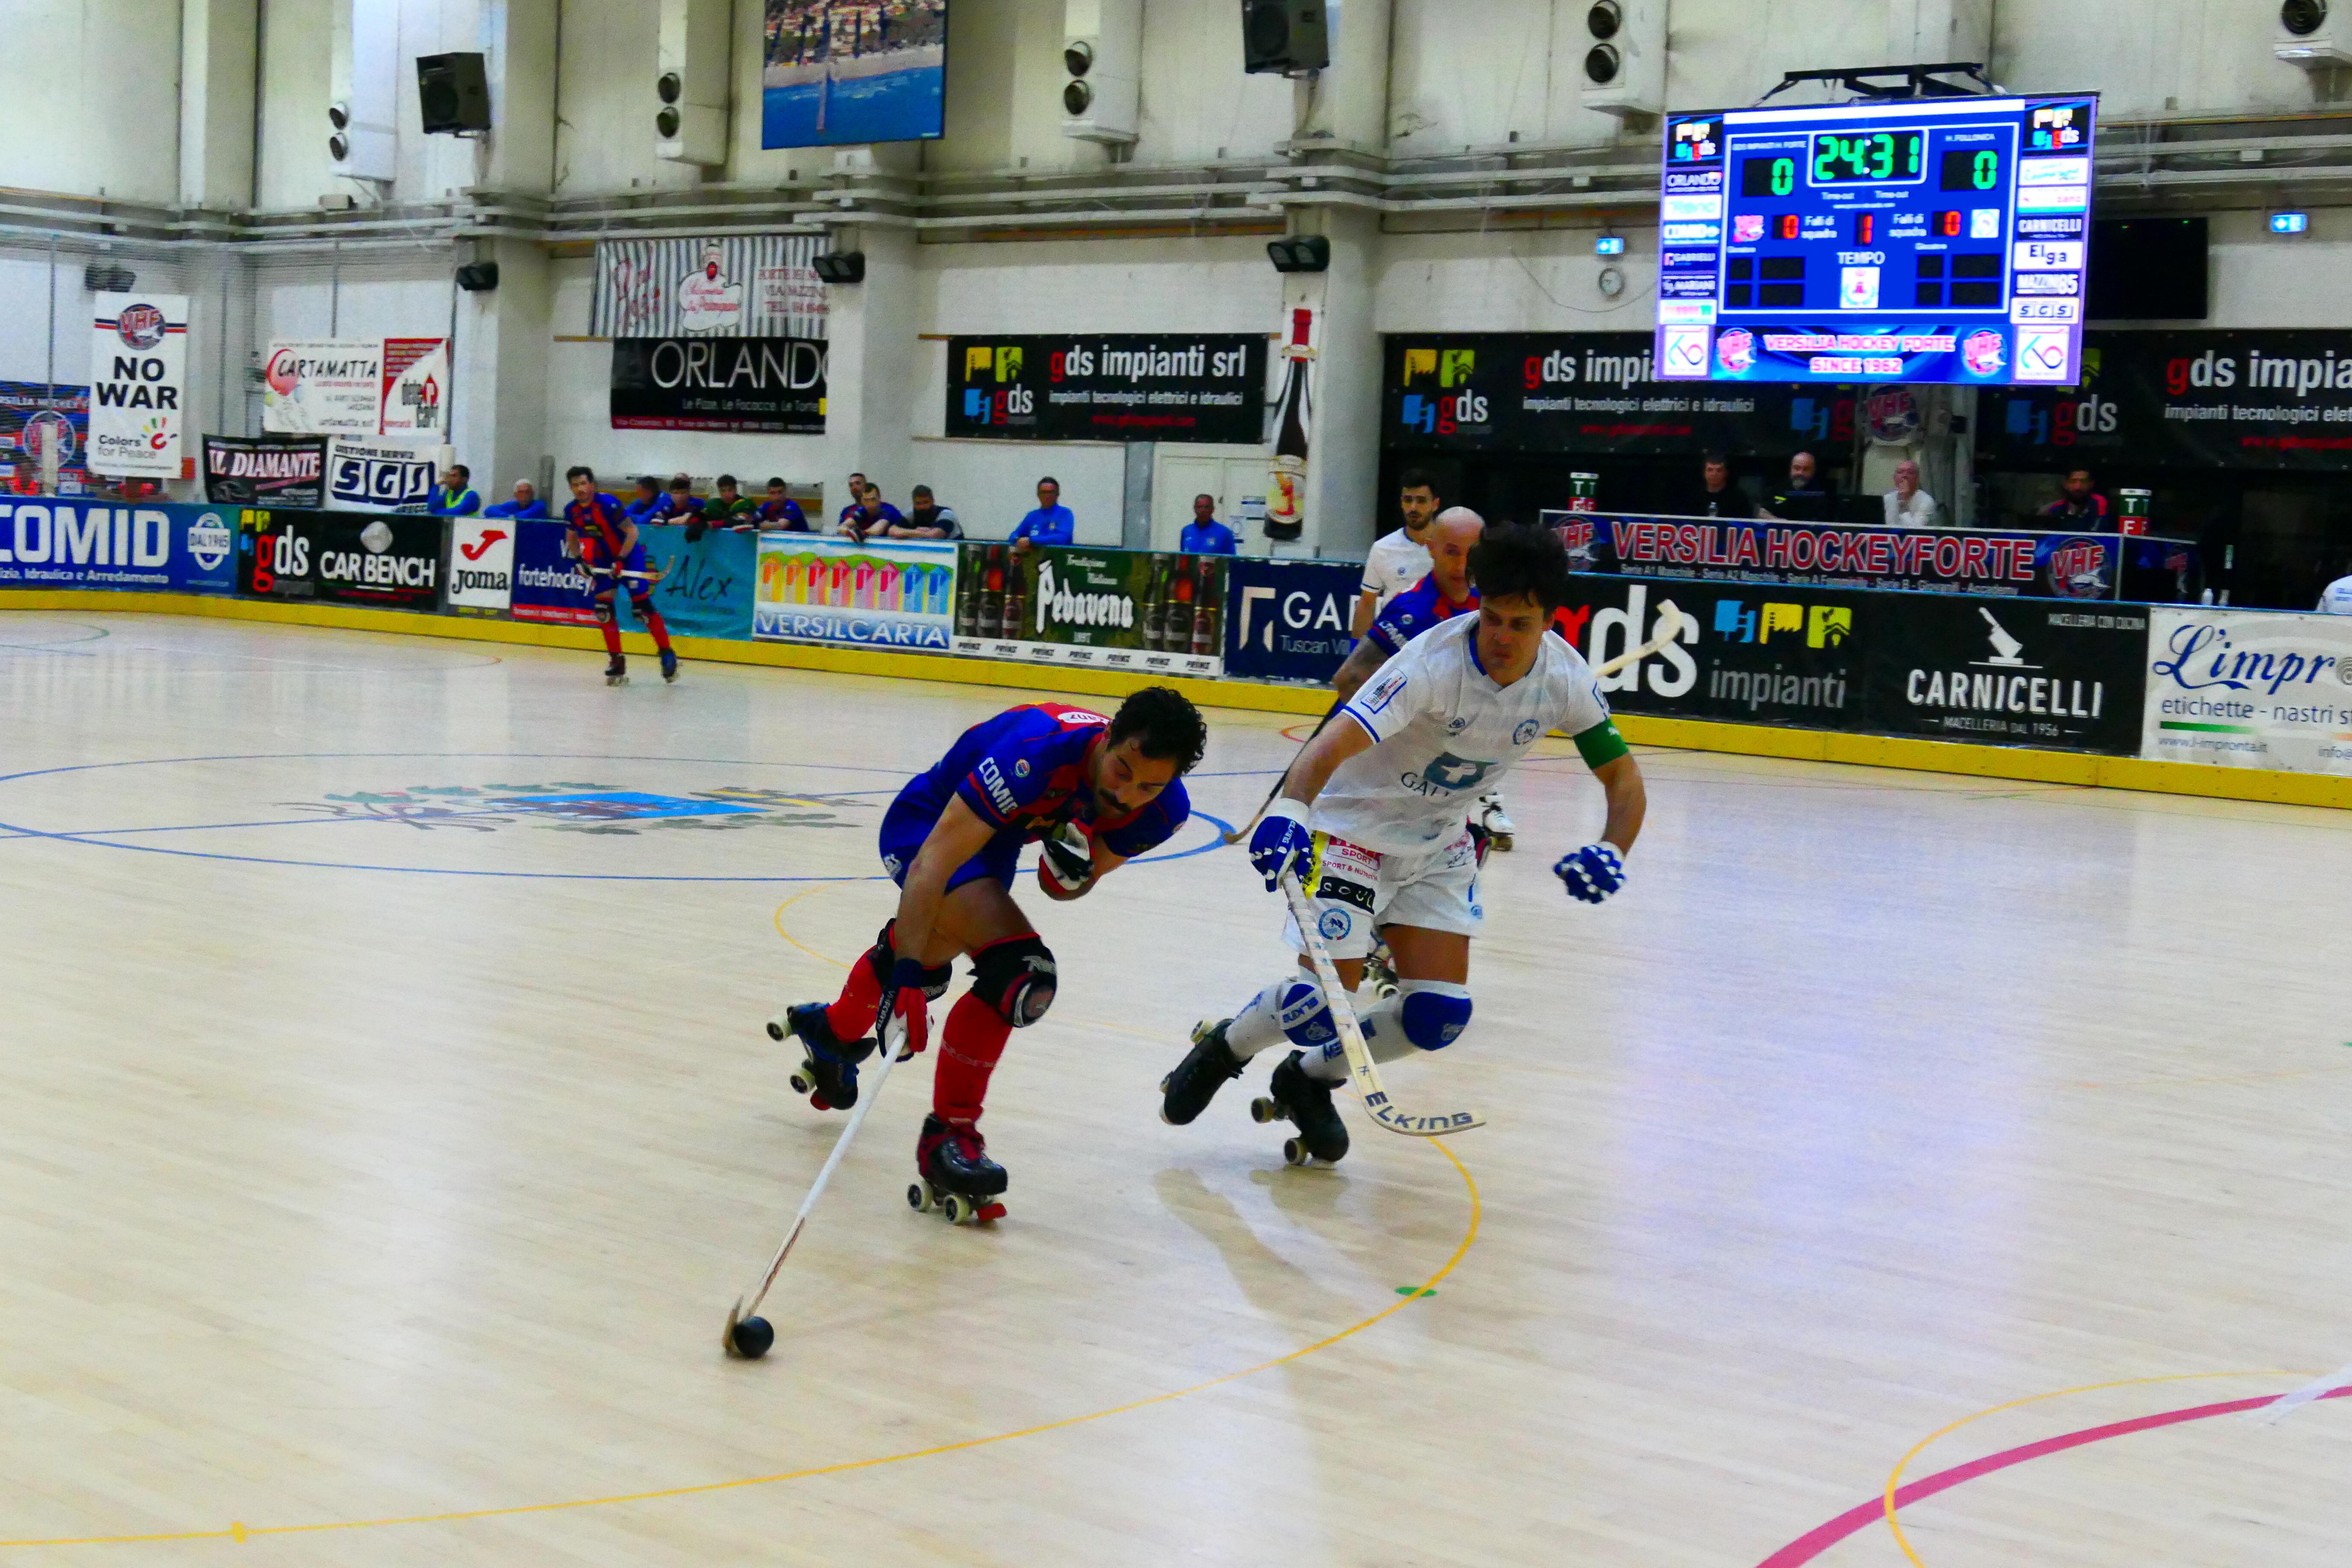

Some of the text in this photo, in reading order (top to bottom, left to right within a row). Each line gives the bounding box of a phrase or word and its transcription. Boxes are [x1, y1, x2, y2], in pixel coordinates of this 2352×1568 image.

[1772, 158, 1794, 195] 0
[1973, 151, 1998, 190] 0
[1783, 215, 1799, 239] 0
[1945, 211, 1961, 236] 0
[1837, 251, 1886, 265] TEMPO
[2030, 245, 2067, 265] Elga
[1763, 334, 1956, 352] VERSILIA HOCKEY FORTE
[114, 356, 164, 381] NO
[278, 359, 377, 378] CARTAMATTA
[1050, 344, 1245, 383] gds impianti srl
[1524, 350, 1576, 389] gds
[1810, 357, 1862, 374] SINCE
[2167, 349, 2236, 395] gds
[96, 383, 177, 409] WAR
[993, 384, 1033, 424] gds
[1438, 389, 1488, 434] gds
[2051, 394, 2118, 446] gds
[2165, 404, 2228, 422] impianti
[2233, 405, 2320, 424] tecnologici
[98, 435, 141, 447] Colors
[209, 450, 321, 478] IL DIAMANTE
[1611, 521, 1759, 567] VERSILIA
[253, 525, 309, 592] gds
[87, 570, 169, 584] Arredamento
[666, 558, 732, 600] Alex
[1036, 560, 1134, 633] Pedavena
[756, 612, 945, 646] VERSILCARTA
[1280, 635, 1329, 653] Tuscan
[1710, 659, 1847, 711] impianti
[1907, 669, 2103, 719] CARNICELLI
[2162, 697, 2254, 719] etichette
[2274, 704, 2333, 724] nastri
[1323, 860, 1346, 870] SPORT
[1342, 848, 1372, 864] SPORT
[1366, 1090, 1474, 1132] ELKING
